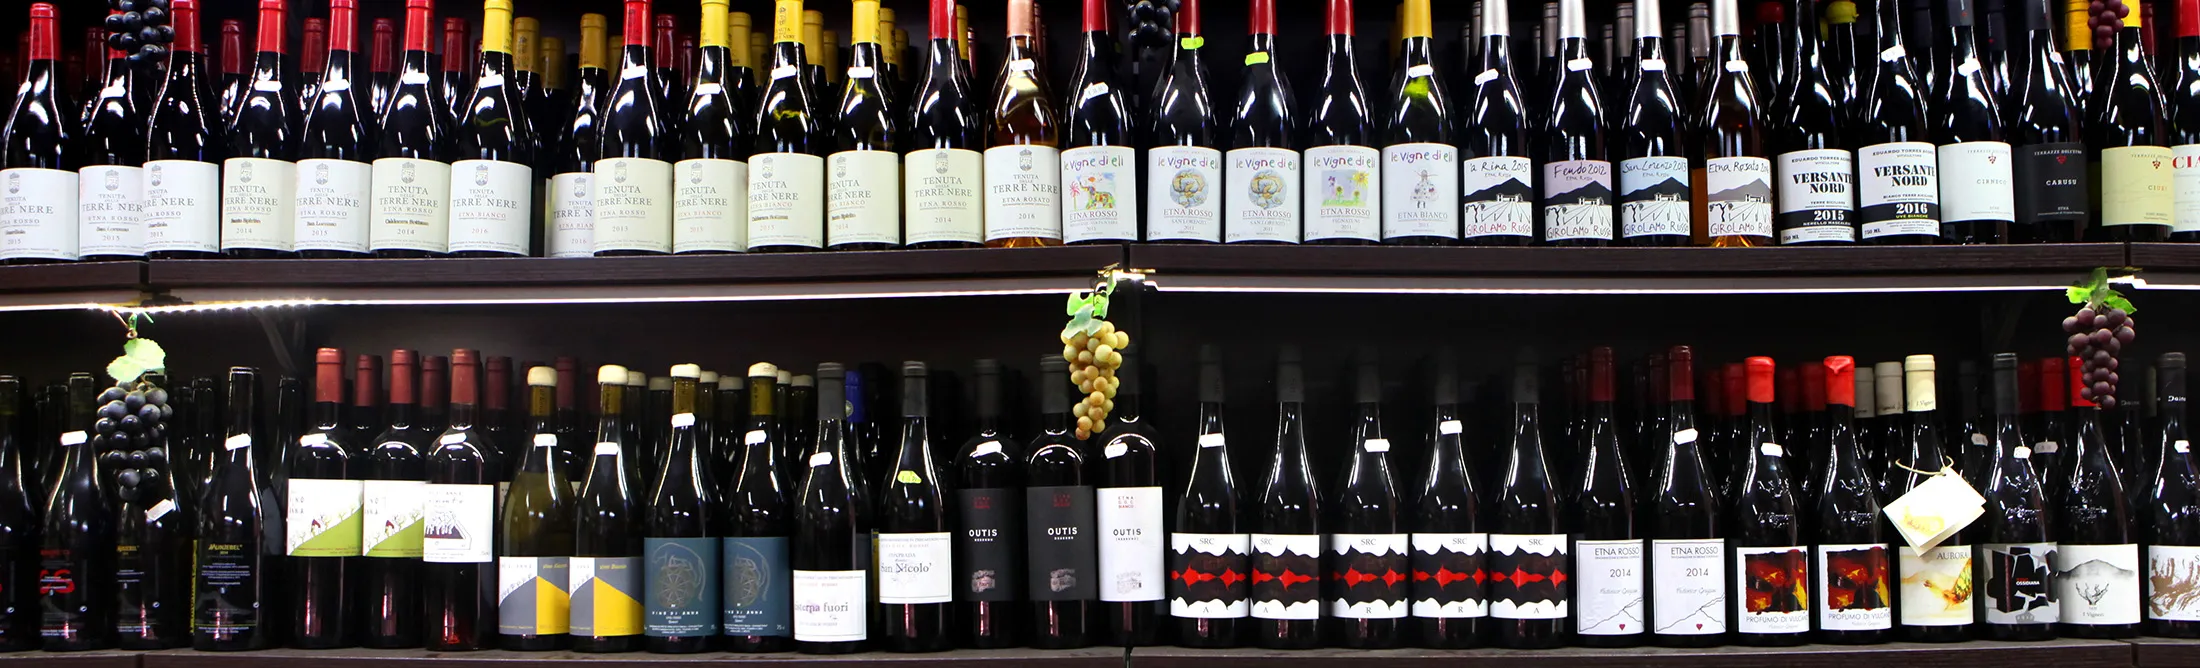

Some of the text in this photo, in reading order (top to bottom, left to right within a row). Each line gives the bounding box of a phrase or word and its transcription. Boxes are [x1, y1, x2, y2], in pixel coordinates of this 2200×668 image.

[1099, 156, 1109, 166] di
[1400, 152, 1430, 164] Vigne
[1432, 150, 1441, 161] di
[1168, 156, 1197, 170] Vigne
[1200, 156, 1208, 167] di
[1246, 158, 1274, 171] Vigne
[1277, 157, 1286, 168] di
[1323, 157, 1352, 170] Vigne
[1355, 156, 1365, 167] di
[1512, 159, 1529, 171] 2015
[1874, 163, 1935, 178] VERSANTE
[922, 176, 963, 186] TENUTA
[1793, 171, 1852, 185] VERSANTE
[1891, 174, 1928, 187] NORD
[2046, 179, 2077, 187] CARUSU
[229, 185, 267, 195] TENUTA
[388, 185, 429, 196] TENUTA
[603, 185, 641, 194] TENUTA
[752, 180, 788, 191] TENUTA
[993, 183, 1059, 195] TERRE NERE
[1808, 182, 1845, 194] NORD
[680, 186, 717, 196] TENUTA
[846, 190, 872, 200] NERE
[914, 187, 973, 198] TERRE NERE
[160, 197, 195, 207] NERE
[250, 197, 279, 207] NERE
[771, 192, 799, 202] NERE
[82, 202, 144, 213] TERRE NER
[327, 198, 360, 208] NERE
[380, 198, 440, 209] TERRE NERE
[453, 199, 518, 210] TERRE NERE
[624, 198, 652, 207] NERE
[701, 198, 728, 207] NERE
[19, 204, 54, 215] NERE
[1163, 208, 1213, 218] ETNA ROSSO
[1320, 209, 1371, 218] ETNA ROSSO
[1895, 202, 1929, 215] 2016
[554, 210, 582, 220] TERRE
[1089, 210, 1118, 220] ROSSO
[1242, 209, 1292, 219] ETNA ROSSO
[1420, 211, 1448, 219] BIANCO
[1813, 208, 1845, 222] 2015
[1466, 223, 1507, 236] GIROLAMO
[1546, 227, 1590, 240] GIROLAMO
[1623, 222, 1666, 236] GIROLAMO
[1710, 223, 1755, 236] GIROLAMO
[968, 527, 998, 538] OUTIS
[1047, 526, 1078, 538] OUTIS
[1112, 528, 1142, 537] OUTIS
[1199, 538, 1214, 546] SRC
[1360, 538, 1376, 546] SRC
[1452, 537, 1467, 545] SRC
[1528, 538, 1543, 546] SRC
[1594, 547, 1640, 556] ETNA ROSSO
[1671, 546, 1719, 555] ETNA ROSSO
[1936, 551, 1969, 561] AURORA
[1609, 568, 1632, 578] 2014
[1685, 568, 1709, 577] 2014
[823, 602, 849, 612] fuori
[1746, 615, 1778, 623] PROFUMO
[1828, 613, 1861, 621] PROFUMO
